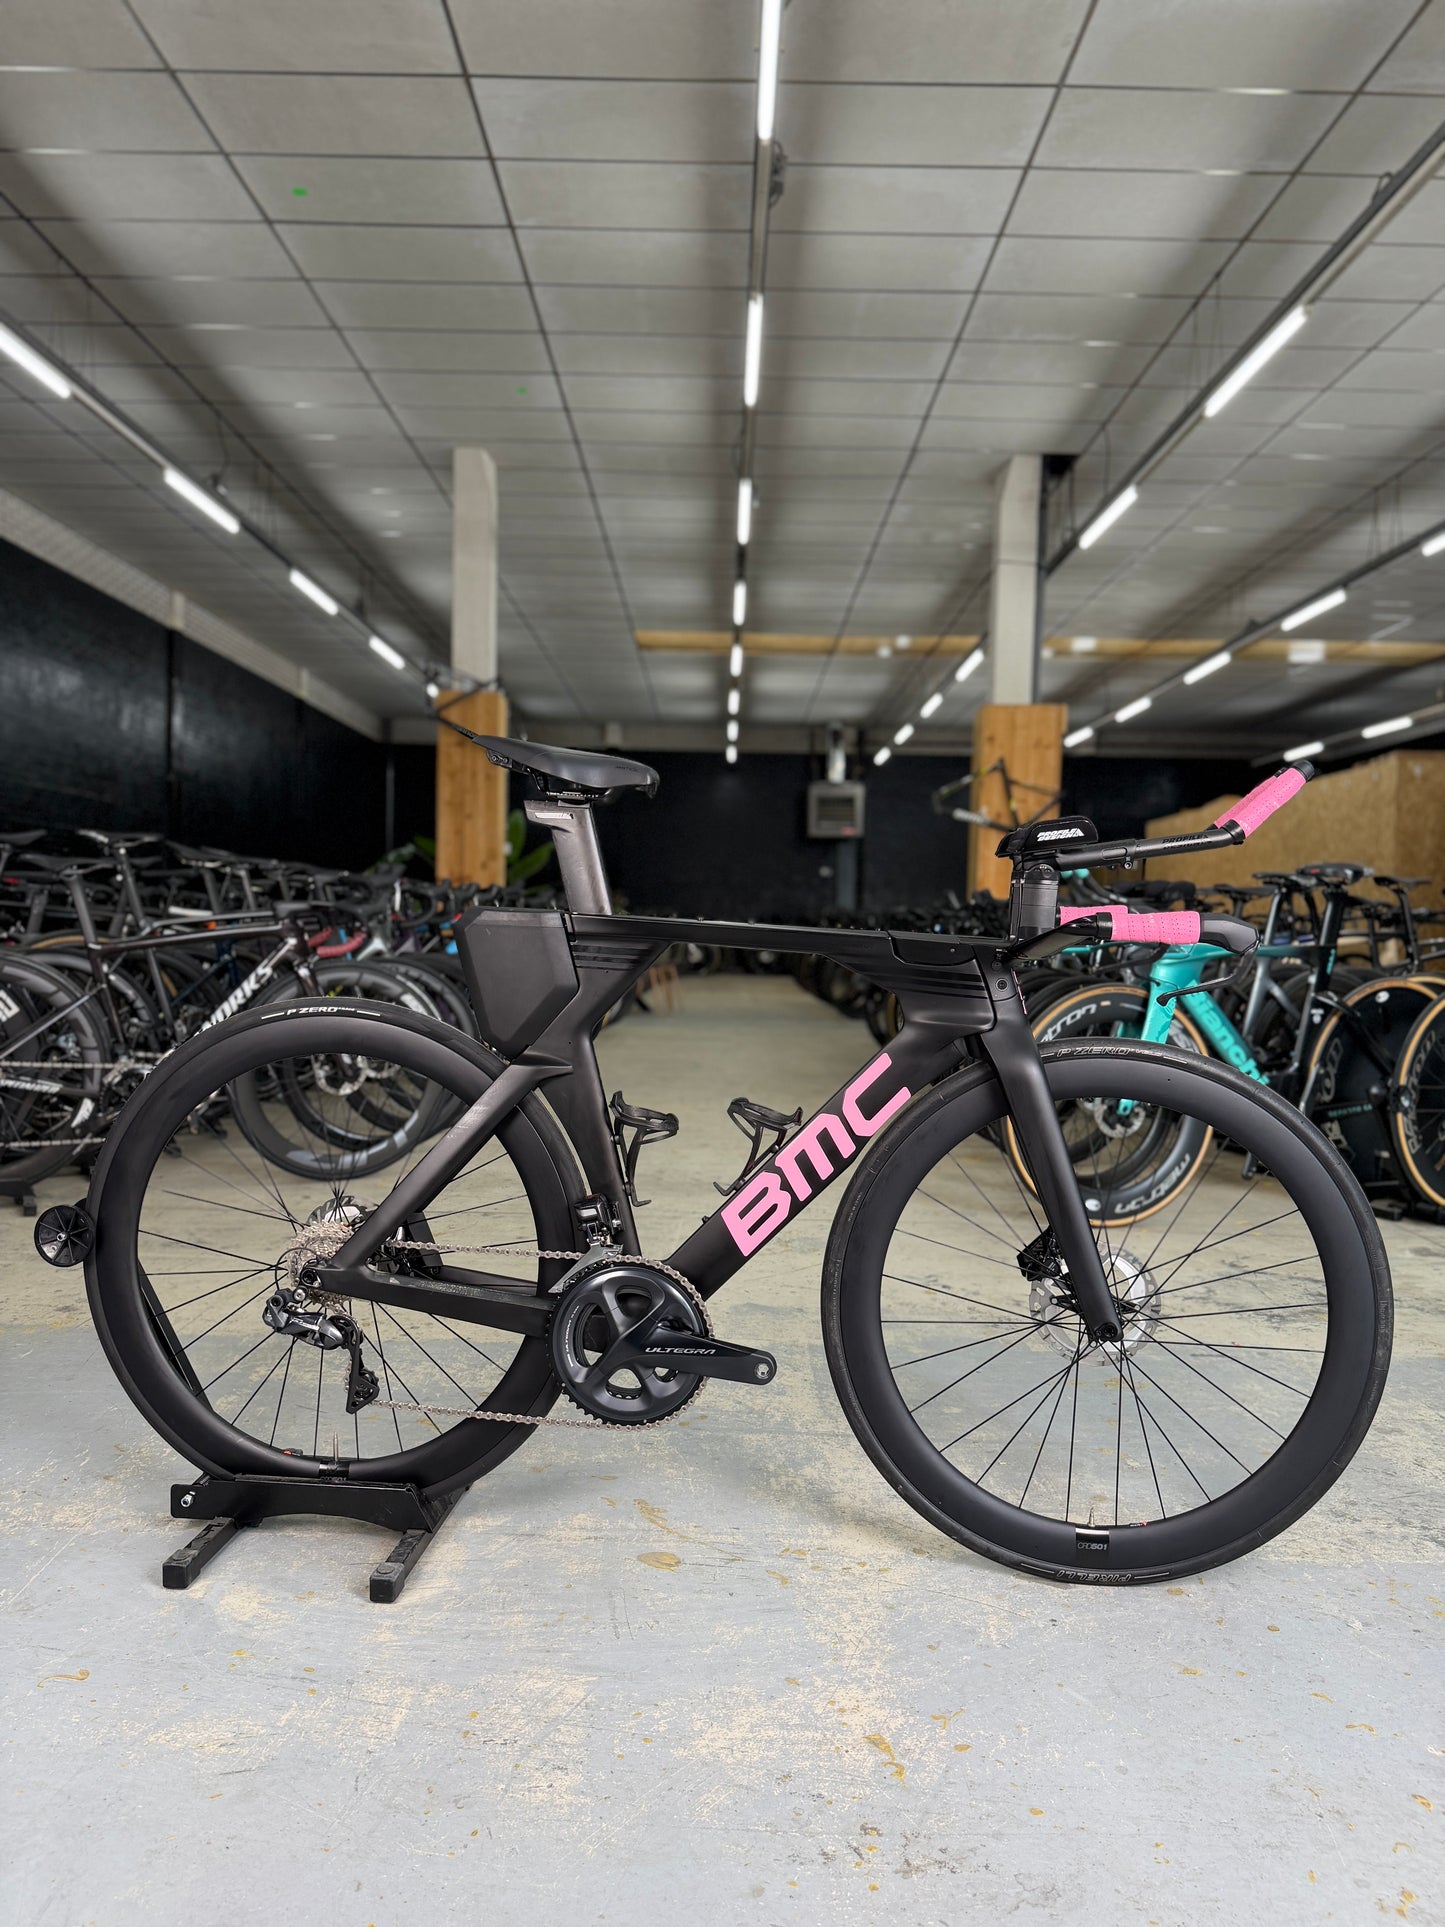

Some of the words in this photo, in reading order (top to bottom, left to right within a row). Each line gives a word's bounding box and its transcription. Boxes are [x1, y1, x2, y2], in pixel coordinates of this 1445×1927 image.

[299, 1006, 338, 1014] ZERO
[1073, 1046, 1131, 1056] ZERO
[720, 1053, 912, 1257] BMC
[645, 1346, 716, 1355] ULTEGRA
[1057, 1569, 1132, 1582] PIRELLI
